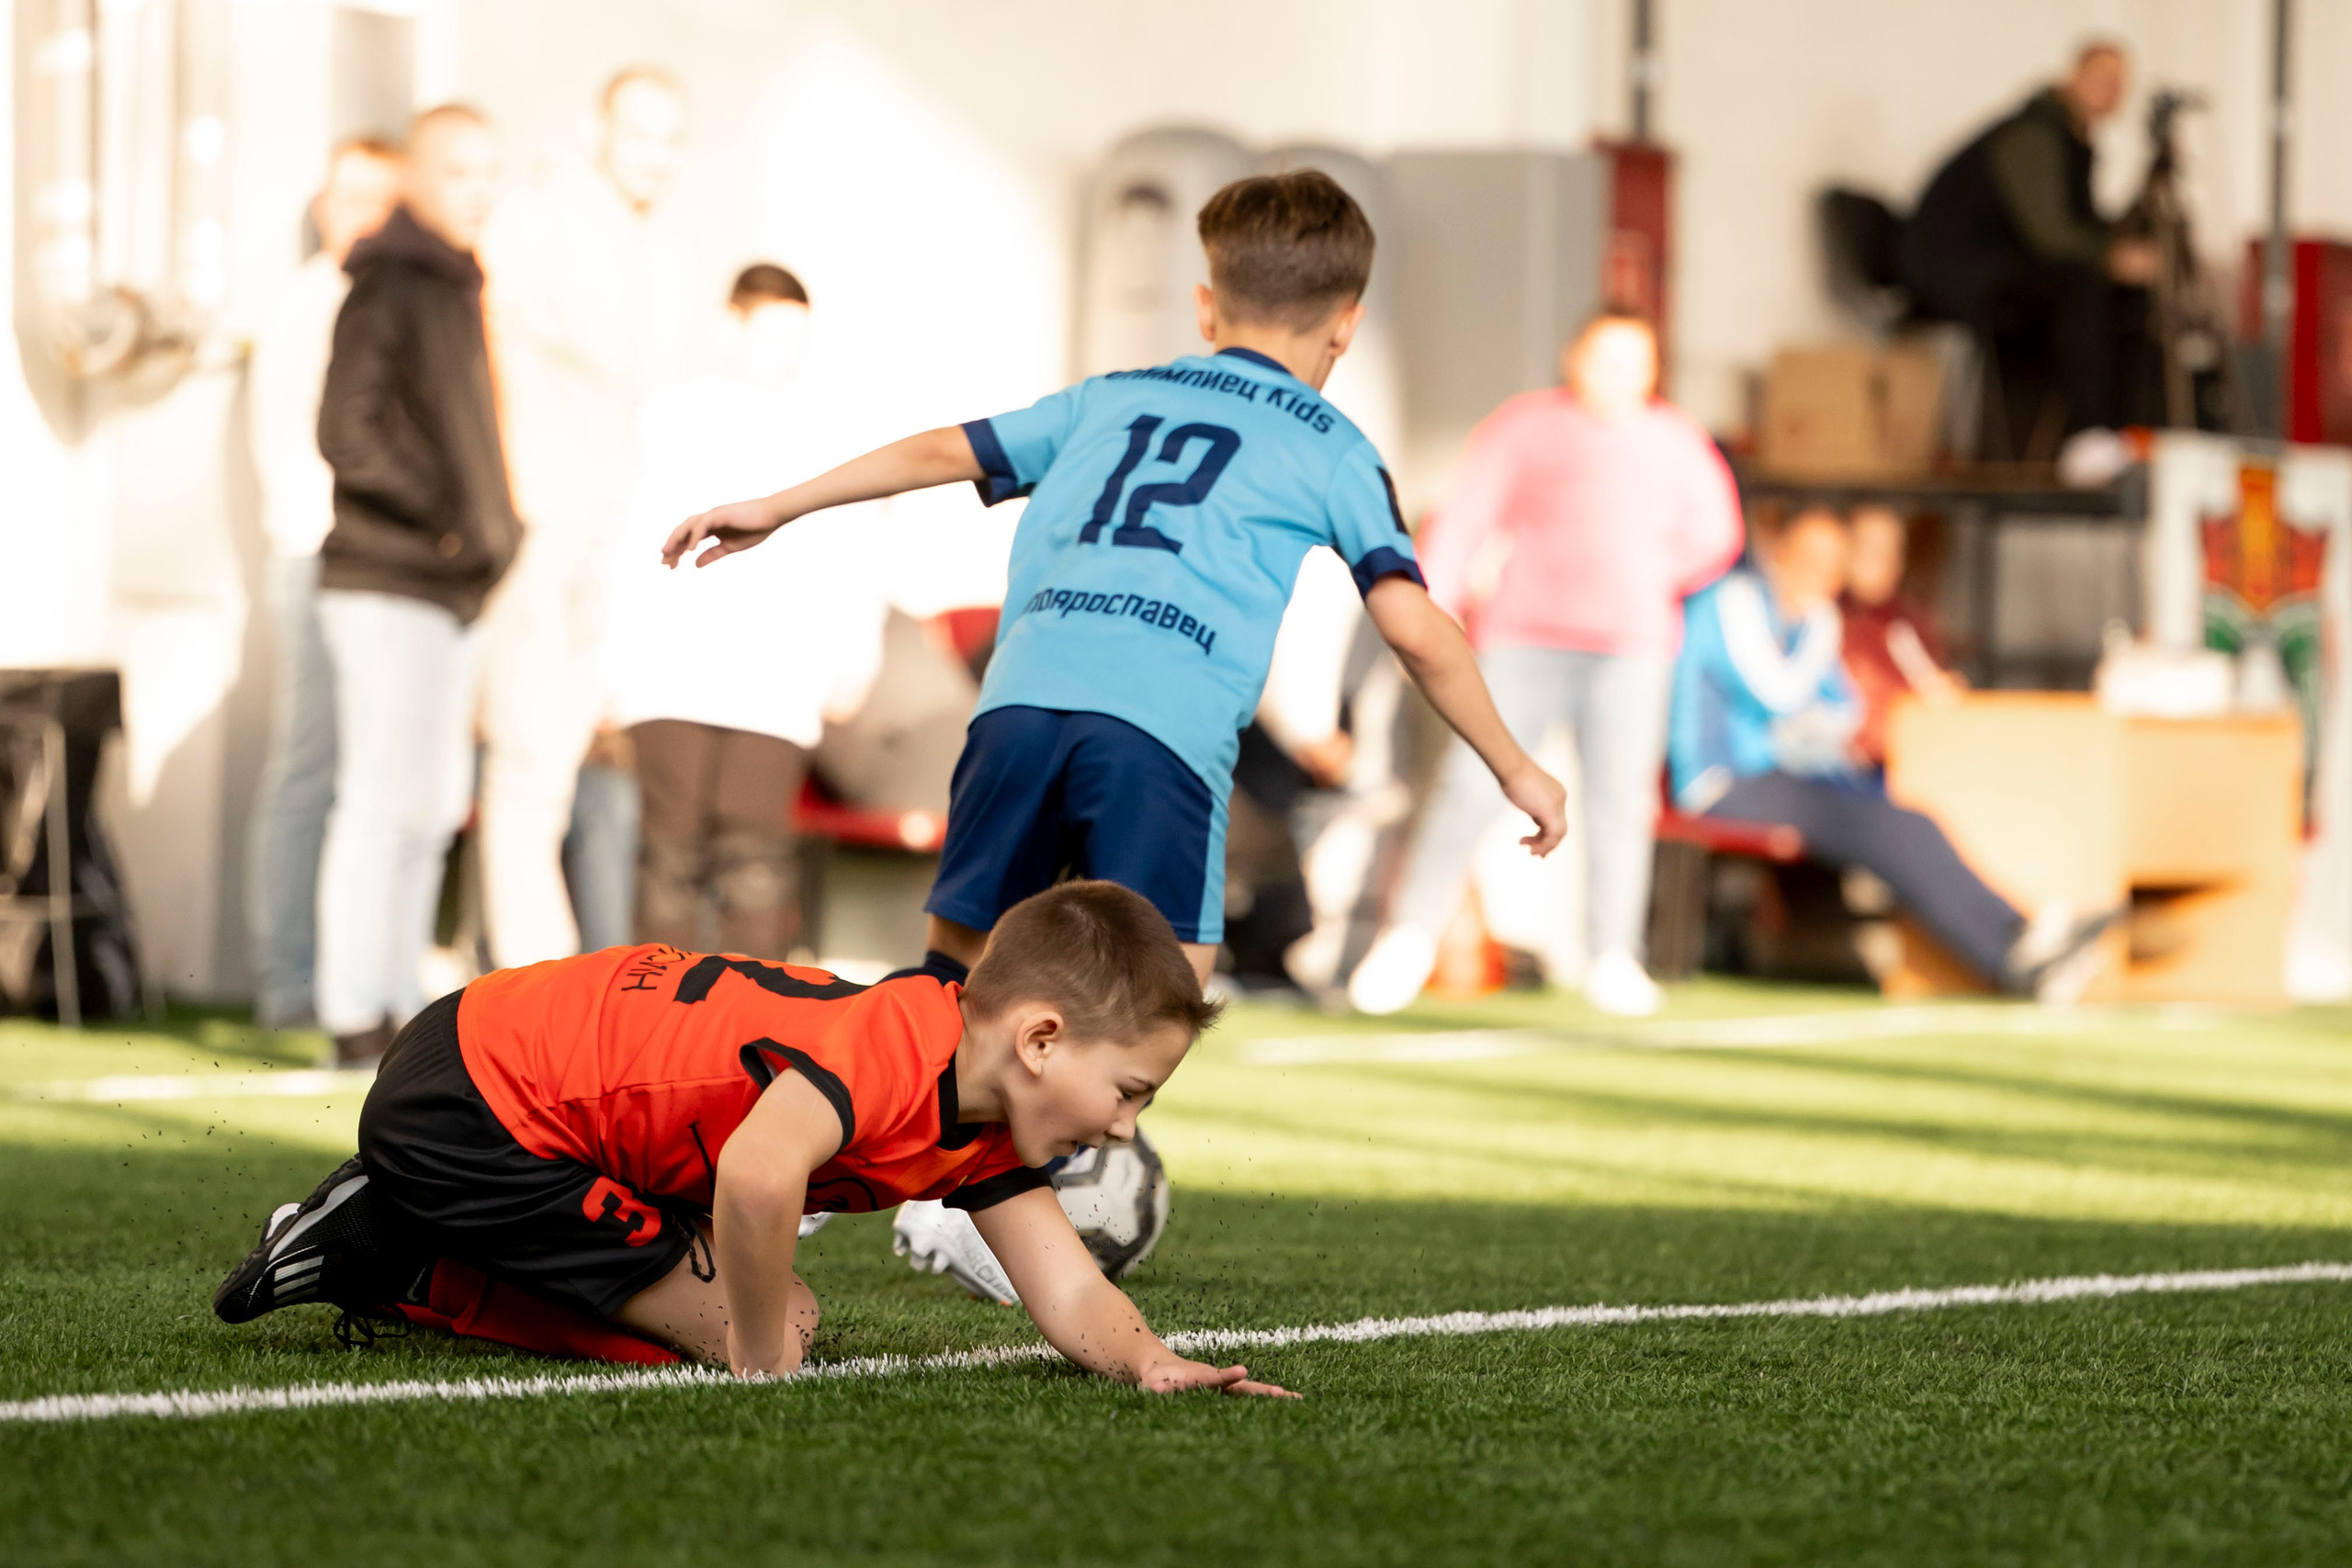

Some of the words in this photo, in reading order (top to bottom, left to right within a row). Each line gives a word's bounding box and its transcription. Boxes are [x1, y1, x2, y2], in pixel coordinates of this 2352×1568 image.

[1265, 386, 1336, 434] Kids
[1078, 414, 1242, 556] 12
[1023, 588, 1216, 656] лоярославец
[582, 1176, 662, 1247] 3
